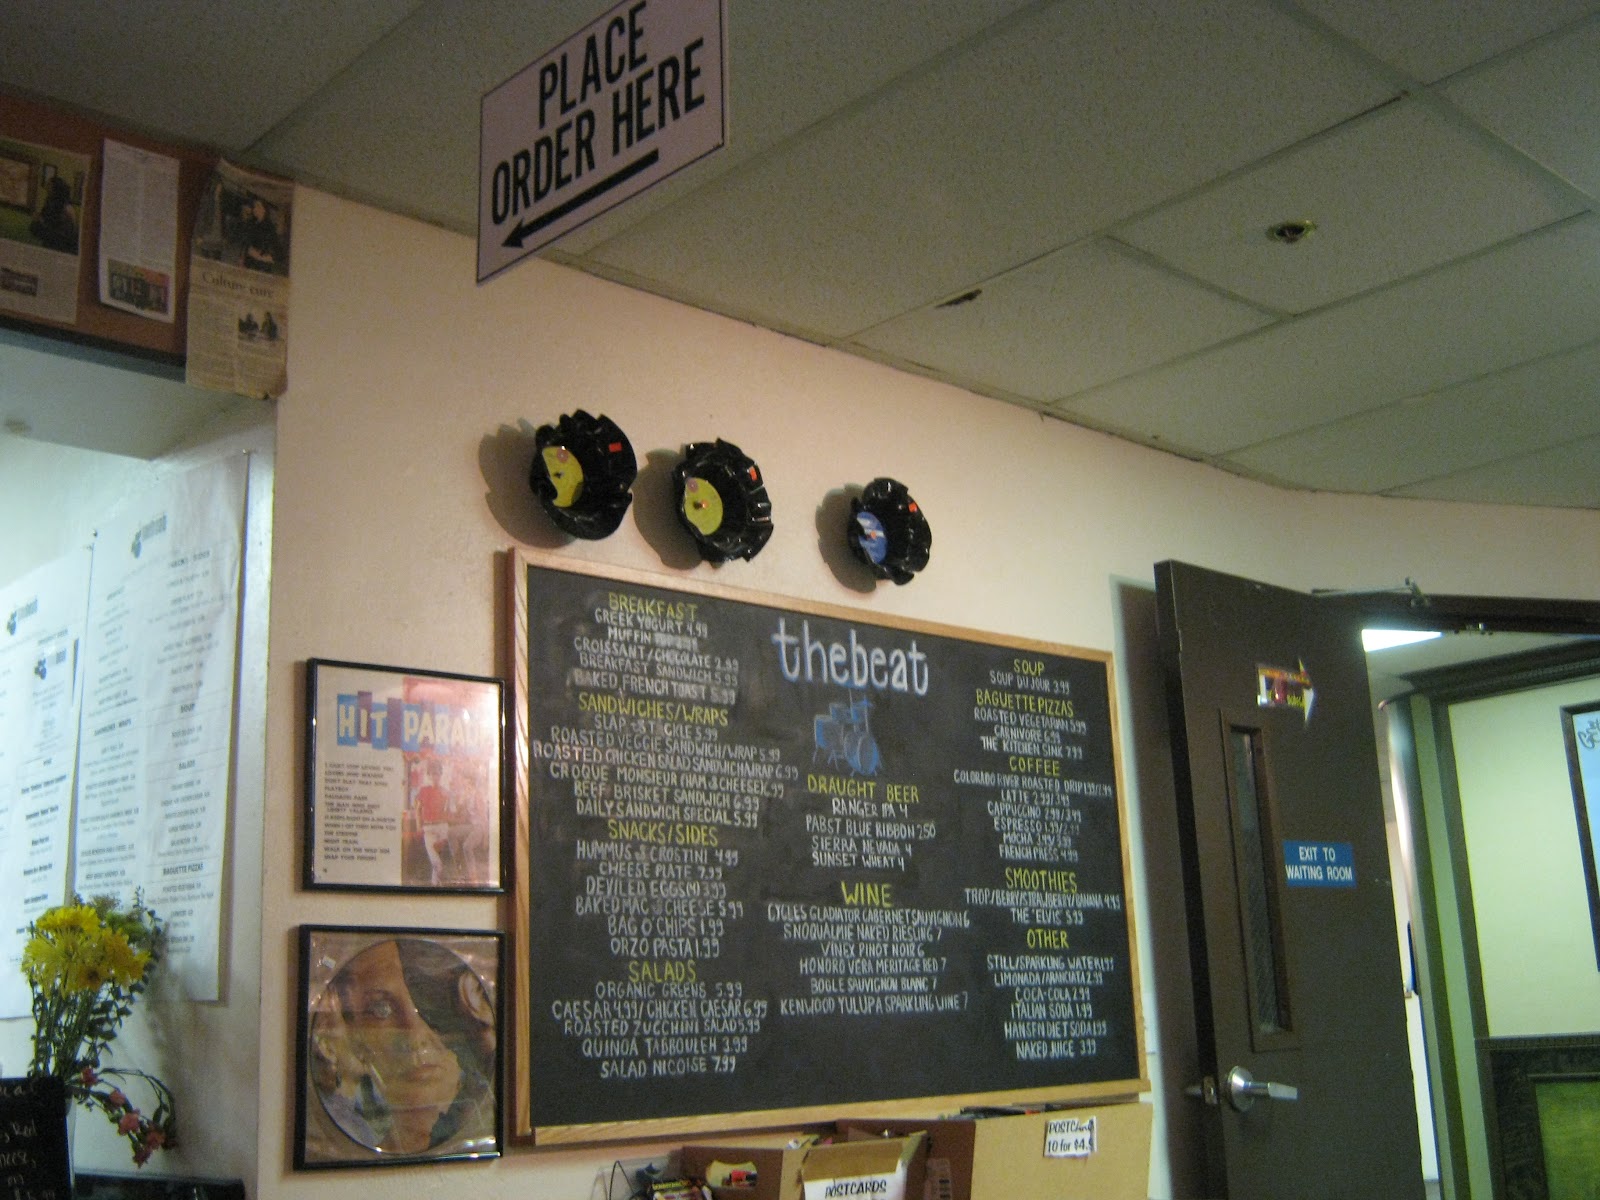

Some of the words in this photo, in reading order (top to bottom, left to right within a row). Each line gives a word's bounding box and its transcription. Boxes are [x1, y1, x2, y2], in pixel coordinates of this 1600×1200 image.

[539, 1, 647, 129] PLACE
[492, 109, 595, 225] ORDER
[612, 37, 705, 157] HERE
[609, 592, 698, 622] BREAKFAST
[595, 608, 633, 626] GREEK
[637, 614, 682, 634] YOGURT
[608, 626, 651, 644] MUFFIN
[580, 652, 648, 674] BREAKFAST
[656, 664, 711, 683] SANDWICH
[1014, 659, 1045, 676] SOUP
[573, 668, 618, 690] BAKED
[622, 675, 668, 698] FRENCH
[671, 680, 706, 699] TOAST
[989, 670, 1013, 686] SOUP
[1017, 674, 1029, 688] DU
[1031, 676, 1050, 692] JOUR
[579, 692, 728, 727] SANDWICHES/WRAPS
[976, 688, 1035, 712] BAGUETTE
[1038, 696, 1073, 718] PIZZAS
[339, 704, 388, 739] HIT
[403, 710, 480, 746] PARAD
[594, 713, 626, 733] SLAP
[649, 720, 692, 740] TCKLE
[974, 707, 1016, 725] ROASTED
[551, 726, 614, 747] ROASTED
[618, 734, 661, 750] VEGGIE
[994, 725, 1042, 742] CARNIVORE
[534, 740, 602, 763] ROASTED
[605, 748, 656, 769] CHICKEN
[658, 755, 691, 771] SALAD
[980, 736, 997, 752] THE
[1003, 738, 1039, 755] KITCHEN
[1042, 744, 1063, 758] SINK
[550, 762, 608, 781] CROQUE
[616, 766, 677, 786] MONSIEUR
[1009, 756, 1060, 776] COFFEE
[808, 774, 876, 799] DRAUGHT
[887, 783, 919, 803] BEER
[954, 769, 995, 786] COLORADO
[997, 773, 1020, 787] RIVER
[1022, 776, 1059, 791] ROASTED
[1064, 779, 1082, 793] DRIP
[574, 780, 605, 798] BEEF
[614, 783, 669, 803] BRISKET
[674, 789, 730, 809] SANDWICH
[1001, 790, 1030, 803] LATTE
[577, 798, 614, 817] DAILY
[617, 801, 679, 820] SANDWICH
[683, 806, 731, 825] SPECIAL
[734, 812, 758, 829] 5.99
[832, 797, 878, 818] RANGER
[882, 802, 896, 818] IPA
[900, 804, 908, 818] 4
[987, 801, 1040, 819] CAPPUCCINO
[806, 814, 841, 834] PABST
[846, 818, 872, 838] BLUE
[876, 822, 915, 839] RIBBON
[994, 816, 1042, 833] ESPRESSO
[812, 835, 857, 852] SIERRA
[863, 839, 900, 855] NEVADA
[905, 843, 912, 857] 4
[1003, 833, 1033, 844] MOCHA
[577, 840, 631, 860] HUMMUS
[650, 846, 707, 863] CROSTINI
[812, 851, 857, 866] SUNSET
[862, 855, 894, 868] WHEAT
[898, 857, 904, 871] 4
[999, 844, 1032, 859] FRENCH
[1033, 845, 1058, 862] PRESS
[1299, 846, 1317, 861] EXIT
[1322, 847, 1336, 862] TO
[599, 861, 650, 879] CHEESE
[656, 863, 691, 879] PLATE
[1005, 867, 1078, 893] SMOOTHIES
[1285, 864, 1323, 880] WAITING
[1326, 866, 1353, 880] ROOM
[586, 876, 646, 897] DEVILED
[841, 881, 893, 907] WINE
[576, 896, 619, 916] BAKED
[622, 898, 648, 915] MAC
[665, 899, 715, 916] CHEESE
[768, 903, 807, 922] CYCLES
[809, 906, 859, 922] GLADIATOR
[862, 909, 910, 925] CABERNET
[1010, 908, 1029, 923] THE
[608, 915, 638, 936] BAG
[656, 918, 696, 937] CHIPS
[784, 923, 853, 940] SNOQUALMIE
[857, 925, 889, 941] NAKED
[892, 927, 932, 942] RIESLING
[936, 928, 942, 941] 7
[611, 938, 648, 956] ORZO
[653, 938, 693, 958] PASTA
[696, 938, 719, 958] 1.99
[1027, 929, 1069, 949] OTHER
[859, 943, 888, 956] PINOT
[892, 943, 915, 957] NOIR
[628, 959, 697, 983] SALADS
[800, 957, 845, 975] HONORO
[849, 959, 873, 974] VERA
[876, 958, 921, 974] MERITAGE
[922, 958, 937, 972] RED
[942, 958, 946, 971] 7
[1067, 956, 1100, 970] WATER
[595, 981, 655, 1000] ORGANIC
[662, 983, 706, 999] GREENS
[715, 982, 742, 997] 5.99
[811, 978, 843, 994] BOGLE
[847, 978, 898, 992] SAUVIGNON
[552, 1000, 612, 1020] CAESAR
[647, 1001, 696, 1019] CHICKEN
[700, 1000, 741, 1019] CAESAR
[781, 997, 834, 1016] KENWOOD
[839, 997, 882, 1014] YULUPA
[885, 994, 934, 1013] SPARKLING
[936, 994, 959, 1011] WINE
[962, 991, 968, 1010] 7
[1011, 1002, 1046, 1019] ITALIAN
[1050, 1003, 1073, 1018] SODA
[564, 1019, 629, 1036] ROASTED
[634, 1022, 699, 1036] ZUCCHINI
[704, 1019, 736, 1033] SALAD
[1047, 1021, 1067, 1037] DIET
[1070, 1021, 1092, 1037] SODA
[582, 1038, 638, 1059] QUINOA
[644, 1038, 716, 1056] TABBOULEH
[722, 1036, 748, 1052] 3.99
[1016, 1040, 1047, 1059] NAKED
[1050, 1041, 1074, 1057] JUICE
[601, 1062, 646, 1079] SALAD
[653, 1056, 706, 1076] NICOISE
[712, 1055, 736, 1073] 7.99
[1048, 1140, 1059, 1153] 10
[1060, 1138, 1072, 1152] for
[825, 1179, 887, 1198] POSTCARDS
